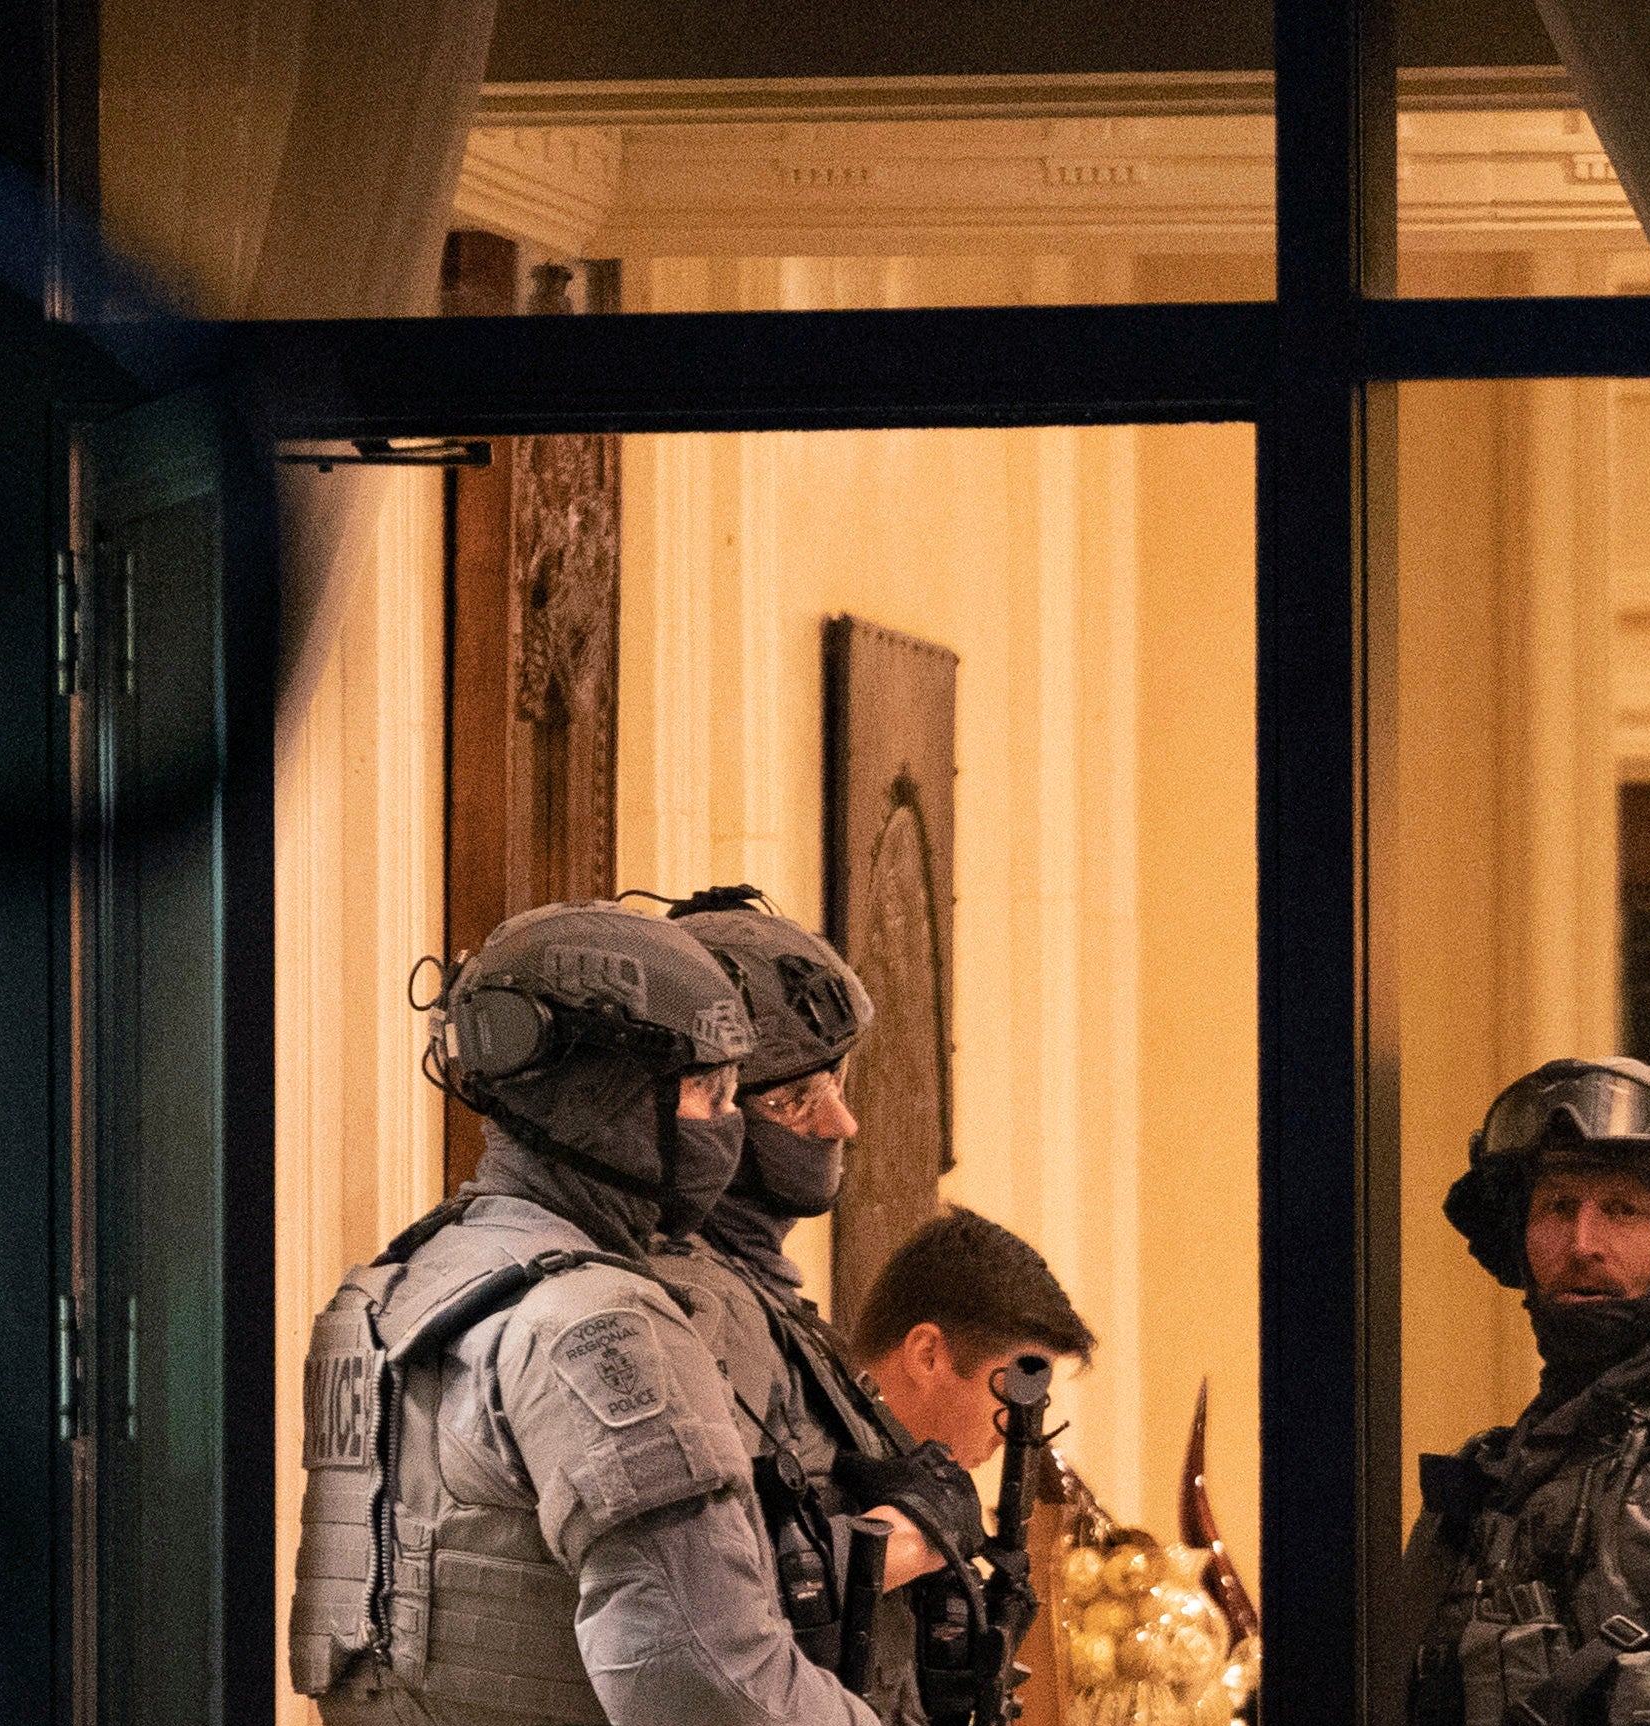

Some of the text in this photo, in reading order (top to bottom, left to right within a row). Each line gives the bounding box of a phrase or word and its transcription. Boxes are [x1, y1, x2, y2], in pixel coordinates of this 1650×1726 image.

[573, 1316, 619, 1341] YORK
[566, 1327, 640, 1360] REGIONAL
[608, 1387, 658, 1416] POLICE
